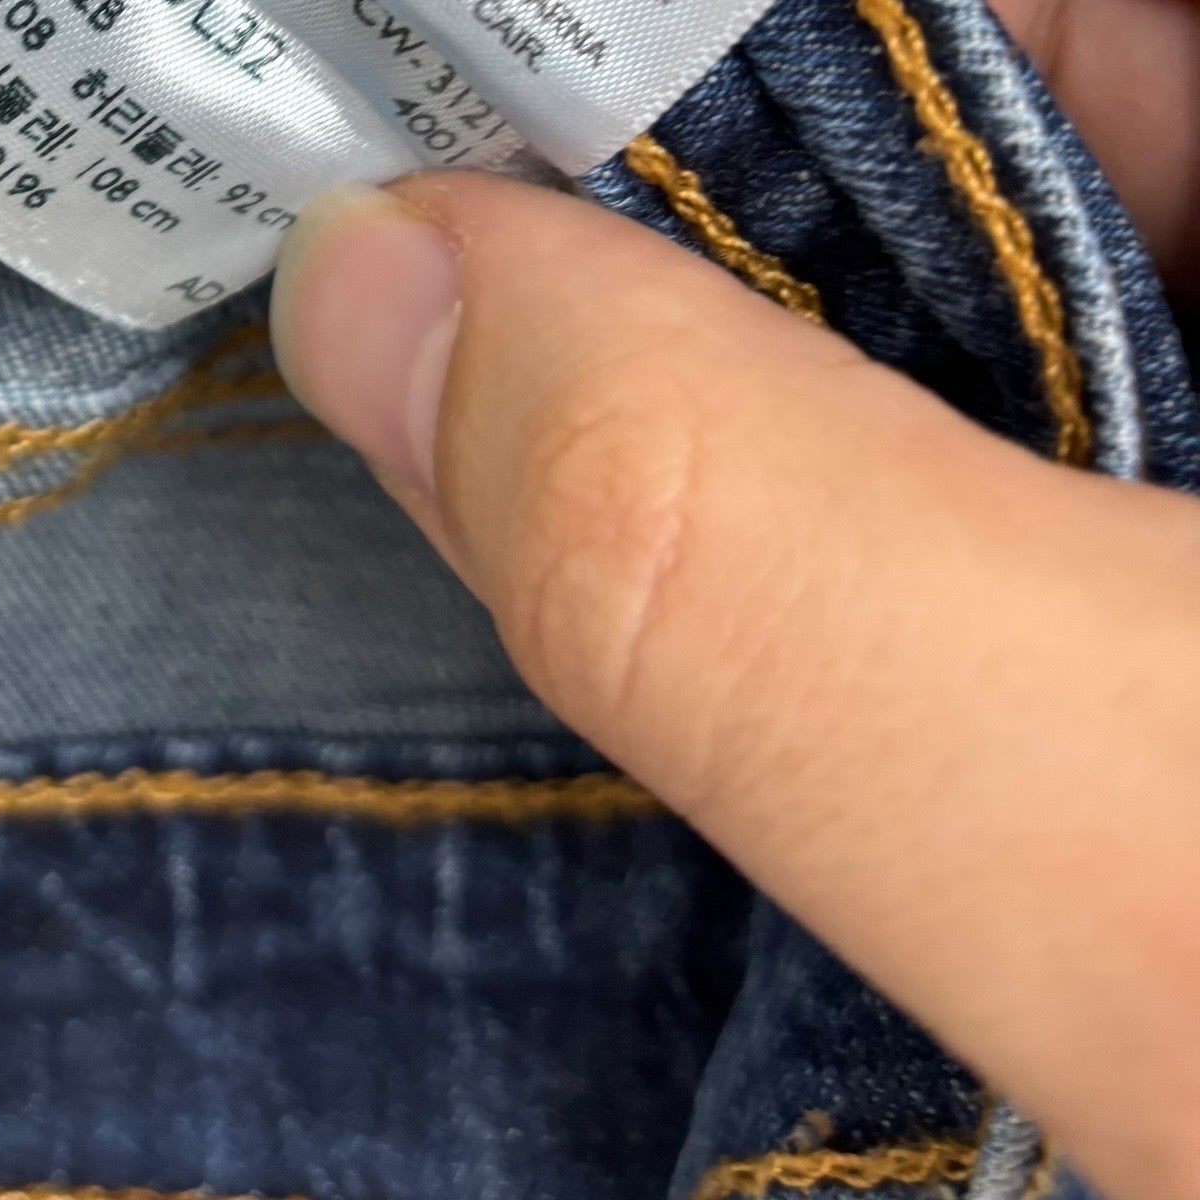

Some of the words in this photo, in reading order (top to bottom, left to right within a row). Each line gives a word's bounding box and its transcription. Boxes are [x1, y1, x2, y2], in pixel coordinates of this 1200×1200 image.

[76, 153, 140, 208] 108
[129, 195, 179, 236] cm
[217, 180, 267, 218] 92
